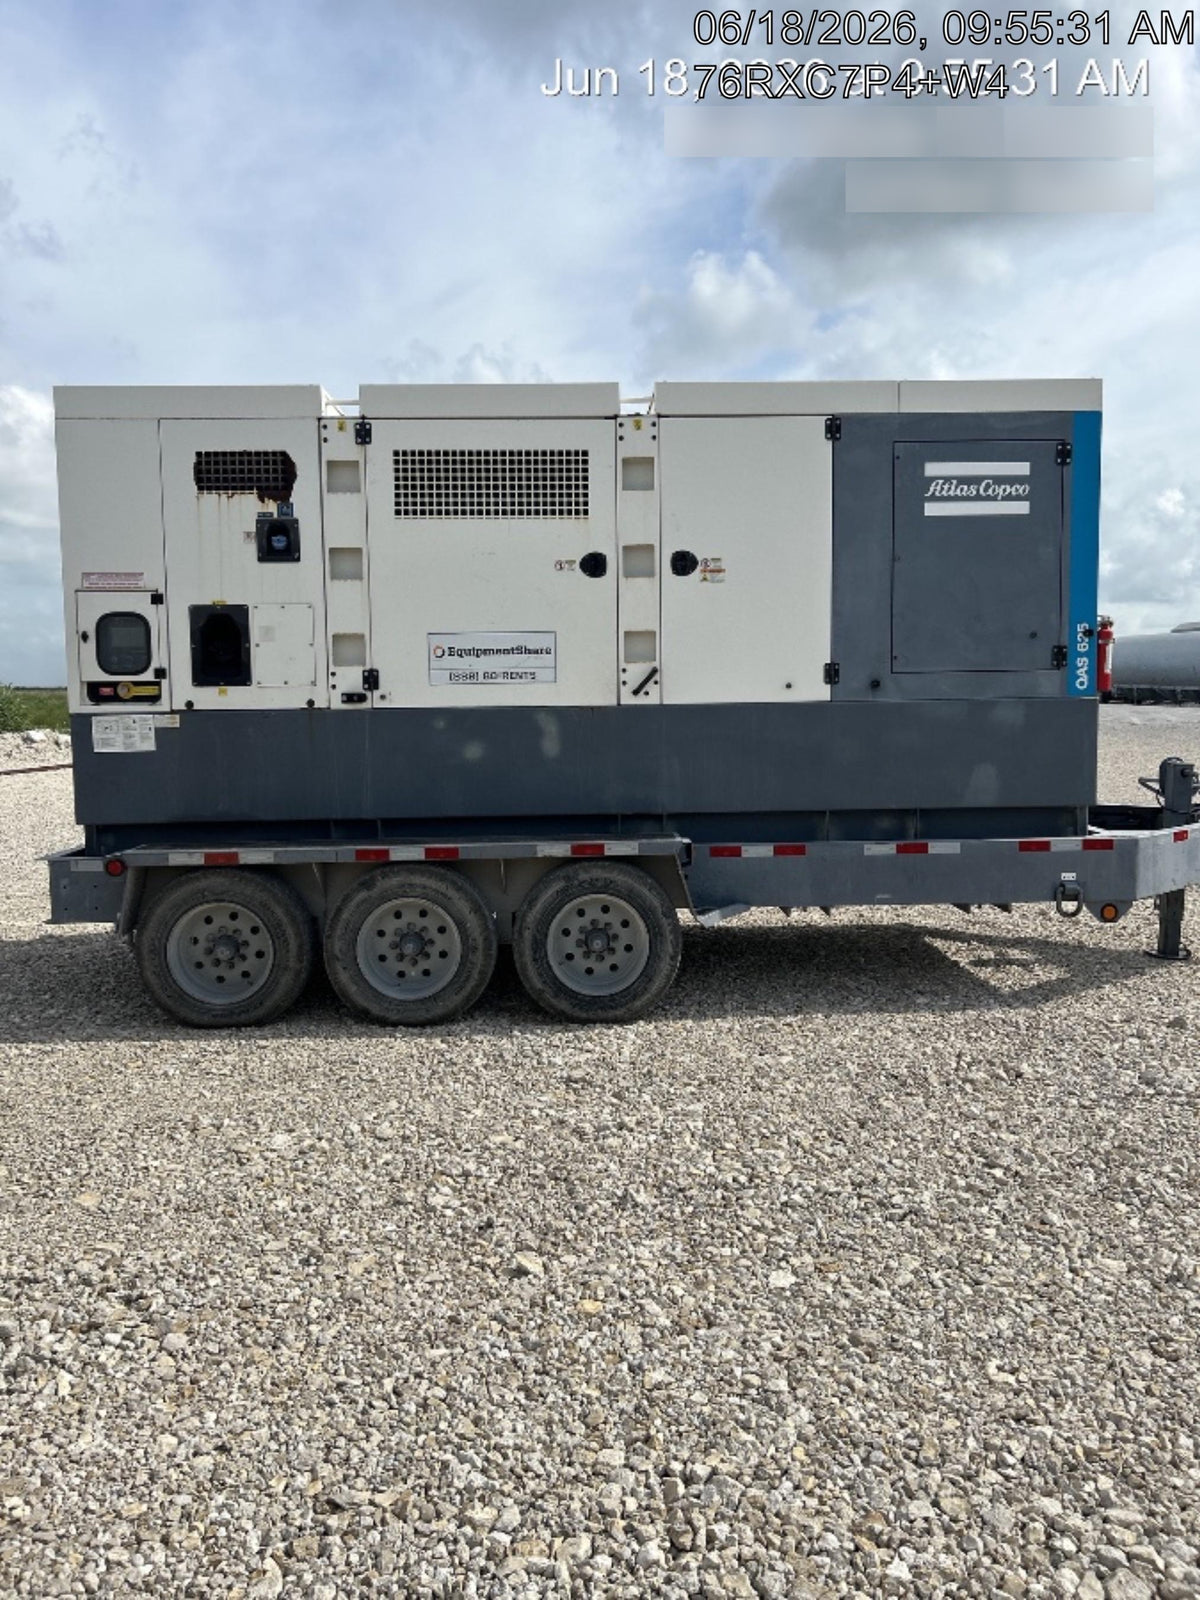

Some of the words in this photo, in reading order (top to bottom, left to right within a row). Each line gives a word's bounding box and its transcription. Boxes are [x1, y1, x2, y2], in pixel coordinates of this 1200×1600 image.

[924, 479, 977, 497] Atlas
[979, 479, 1030, 501] Copco
[1077, 622, 1089, 652] 625
[447, 645, 552, 659] EquipmentShare
[1075, 657, 1089, 690] QAS
